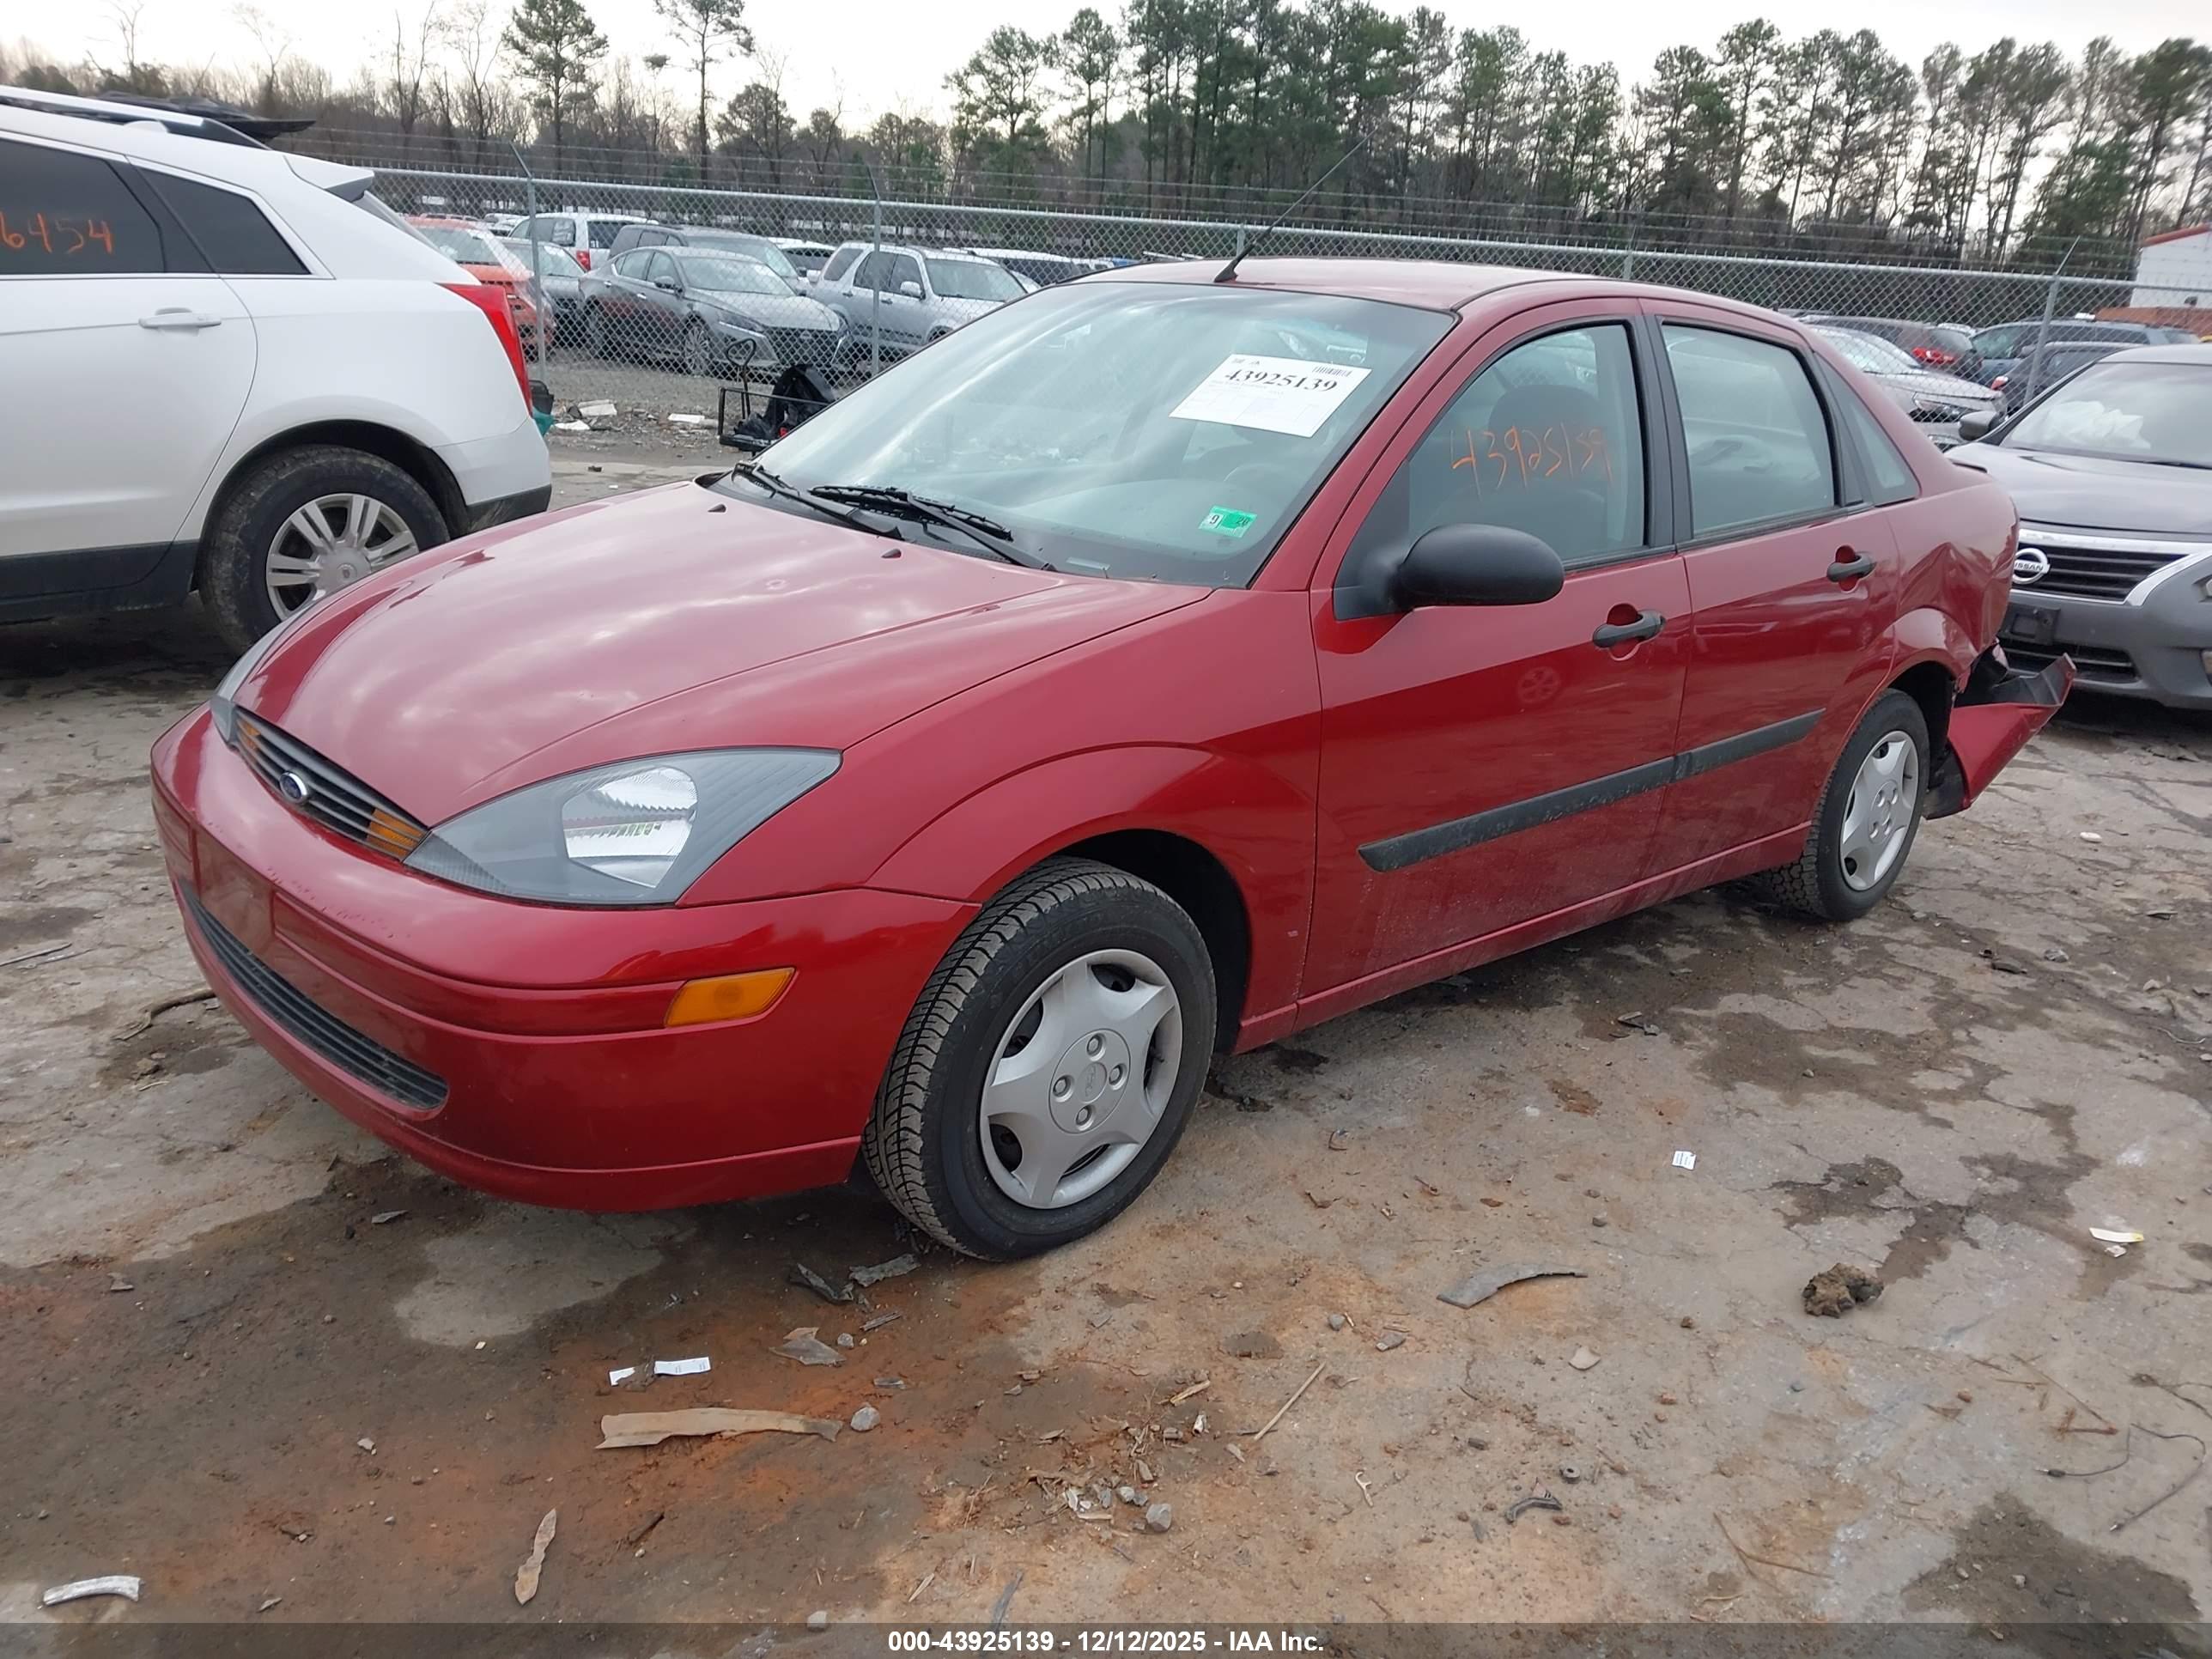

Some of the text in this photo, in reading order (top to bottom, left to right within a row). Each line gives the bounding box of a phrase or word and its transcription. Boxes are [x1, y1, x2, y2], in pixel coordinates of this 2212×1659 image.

[1224, 369, 1338, 392] 43925139
[1449, 422, 1613, 501] 43925139
[2014, 562, 2044, 571] ISSAN
